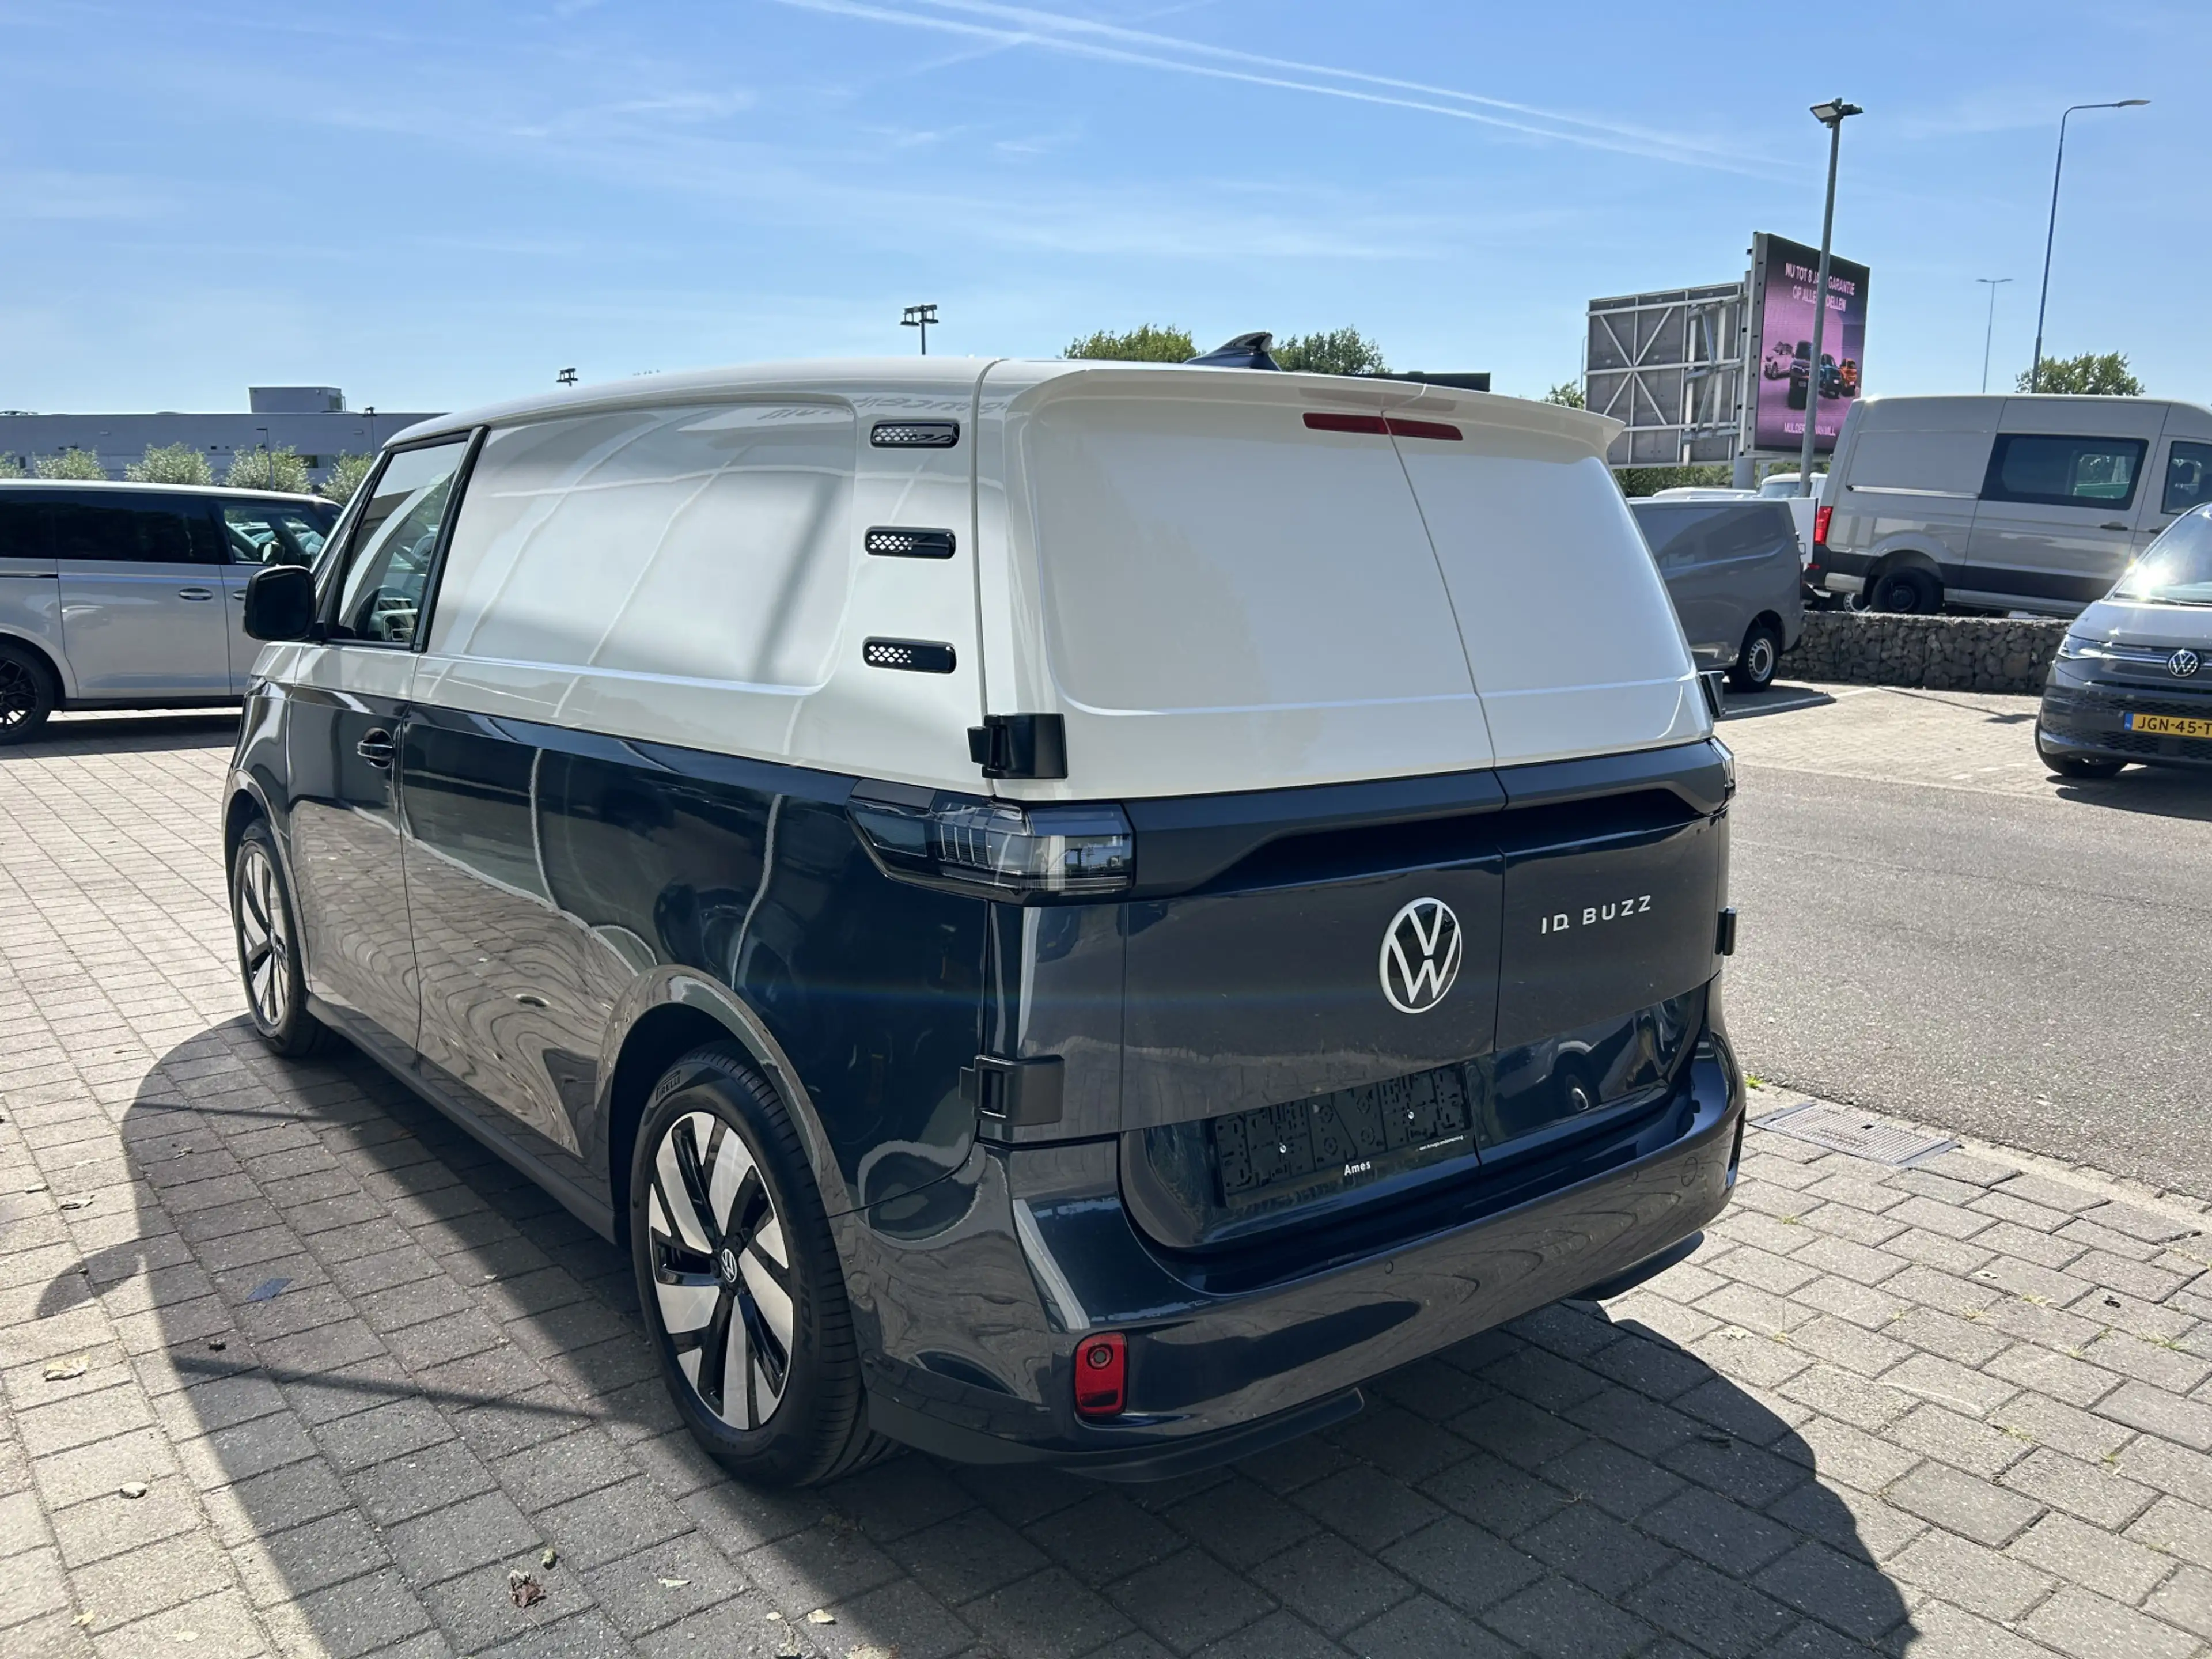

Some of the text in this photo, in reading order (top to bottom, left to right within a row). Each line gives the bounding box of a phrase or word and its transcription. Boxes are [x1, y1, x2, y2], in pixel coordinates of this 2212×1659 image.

[1785, 262, 1796, 278] NU
[1796, 266, 1807, 282] TOT
[1828, 275, 1855, 296] GARANTIE
[1792, 285, 1802, 300] OP
[2138, 717, 2212, 736] JGN-45-T
[1582, 895, 1651, 925] BUZZ
[656, 1069, 681, 1101] PIRELLI
[1344, 1161, 1371, 1176] Ames
